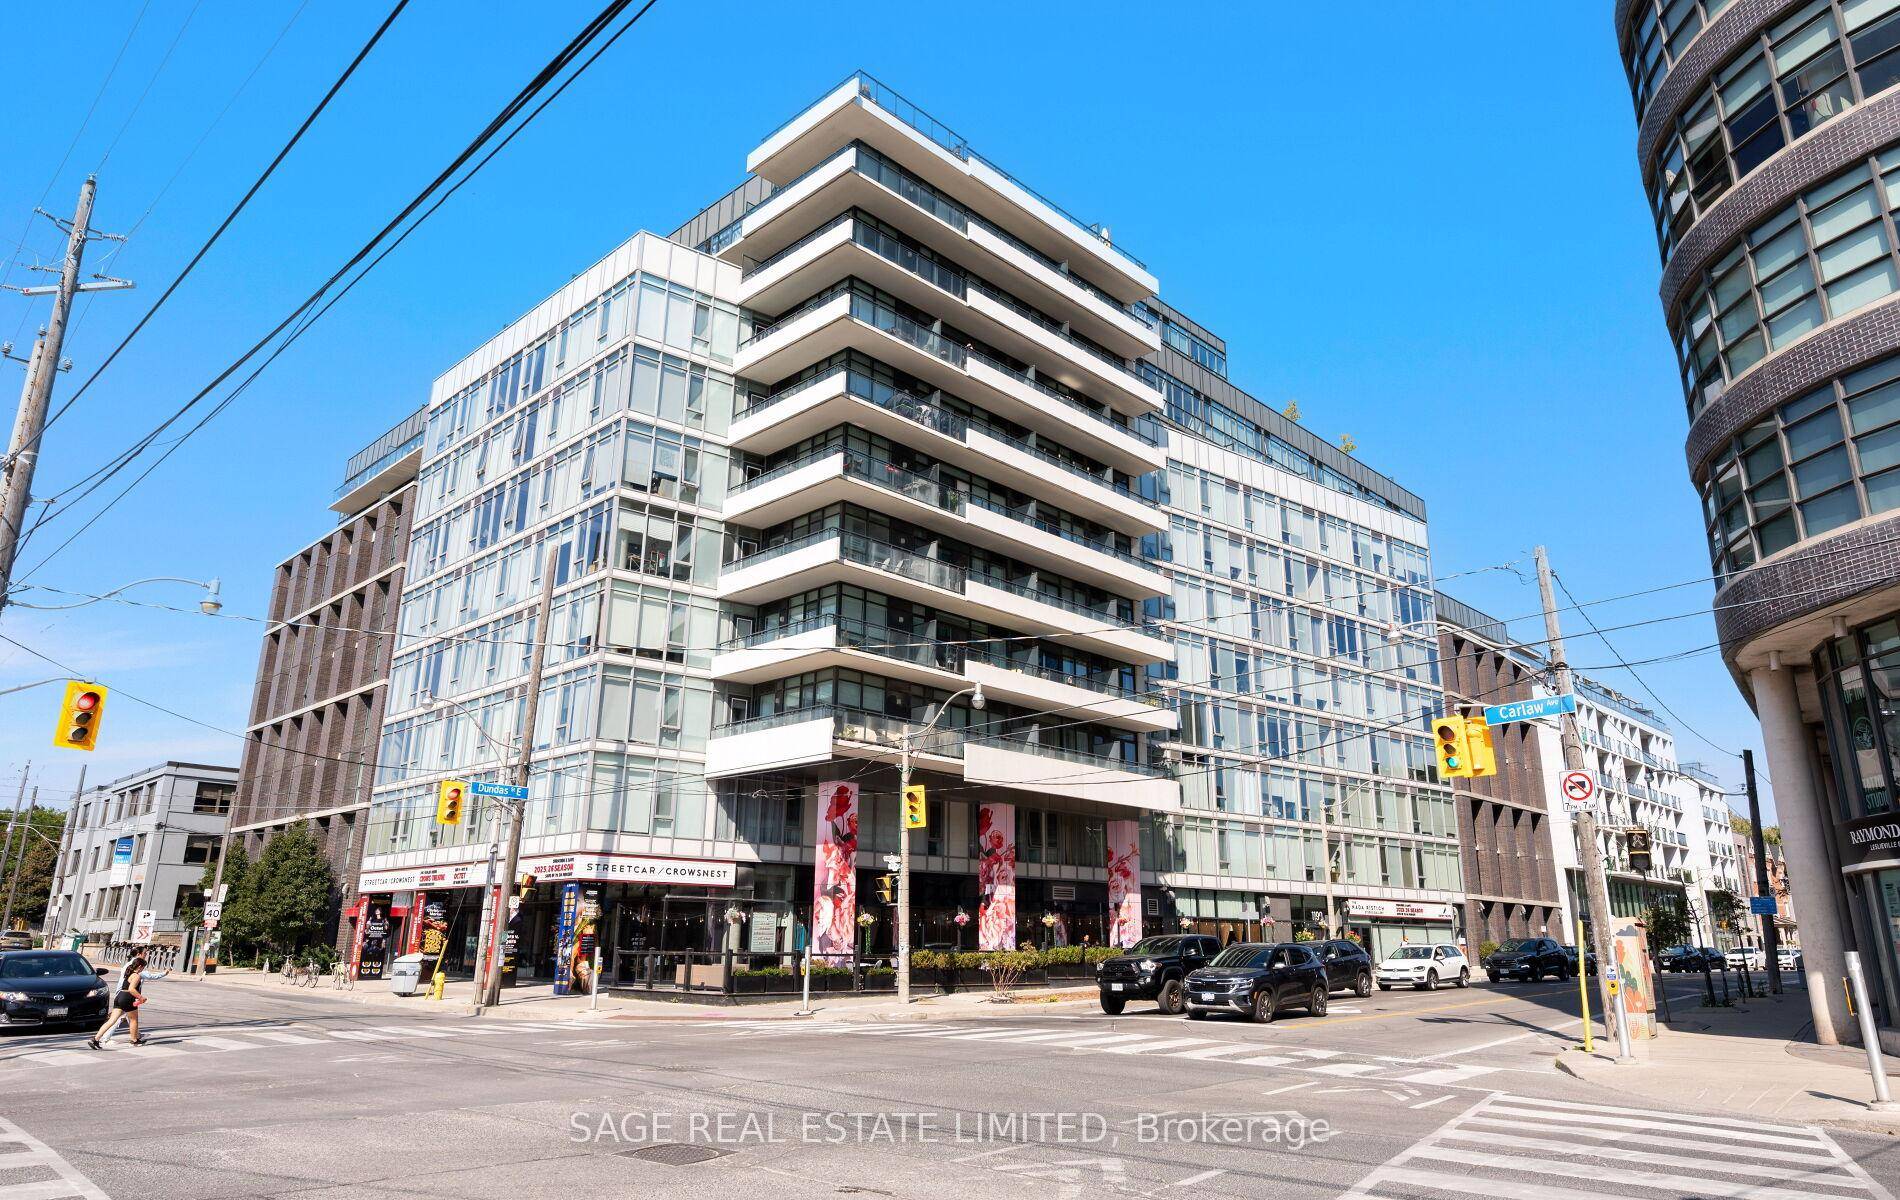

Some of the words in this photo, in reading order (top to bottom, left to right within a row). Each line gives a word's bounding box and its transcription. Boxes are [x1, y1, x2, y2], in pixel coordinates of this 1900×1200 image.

[1499, 703, 1545, 719] Carlaw
[1546, 699, 1559, 707] Ave
[477, 784, 509, 795] Dundas
[516, 788, 522, 796] E
[206, 909, 220, 918] 40
